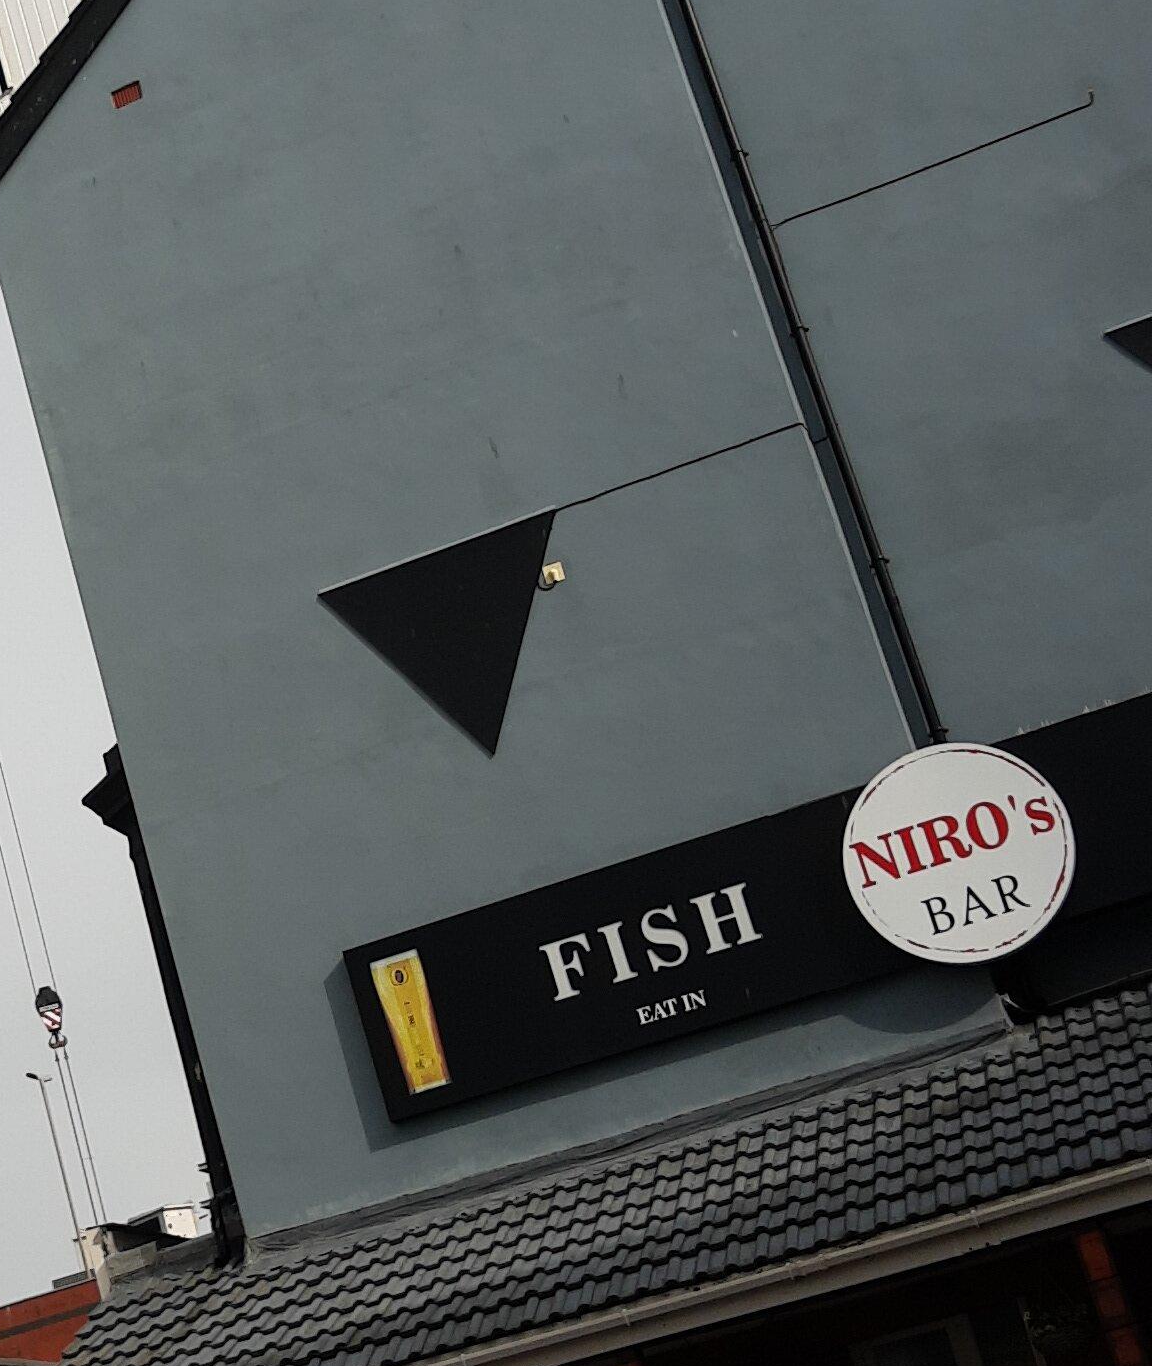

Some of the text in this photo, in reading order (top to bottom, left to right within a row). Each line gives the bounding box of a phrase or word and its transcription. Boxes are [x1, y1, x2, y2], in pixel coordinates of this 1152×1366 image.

[849, 795, 1056, 889] NIRO's
[538, 882, 764, 1002] FISH
[921, 874, 1031, 935] BAR
[635, 989, 708, 1026] EAT IN
